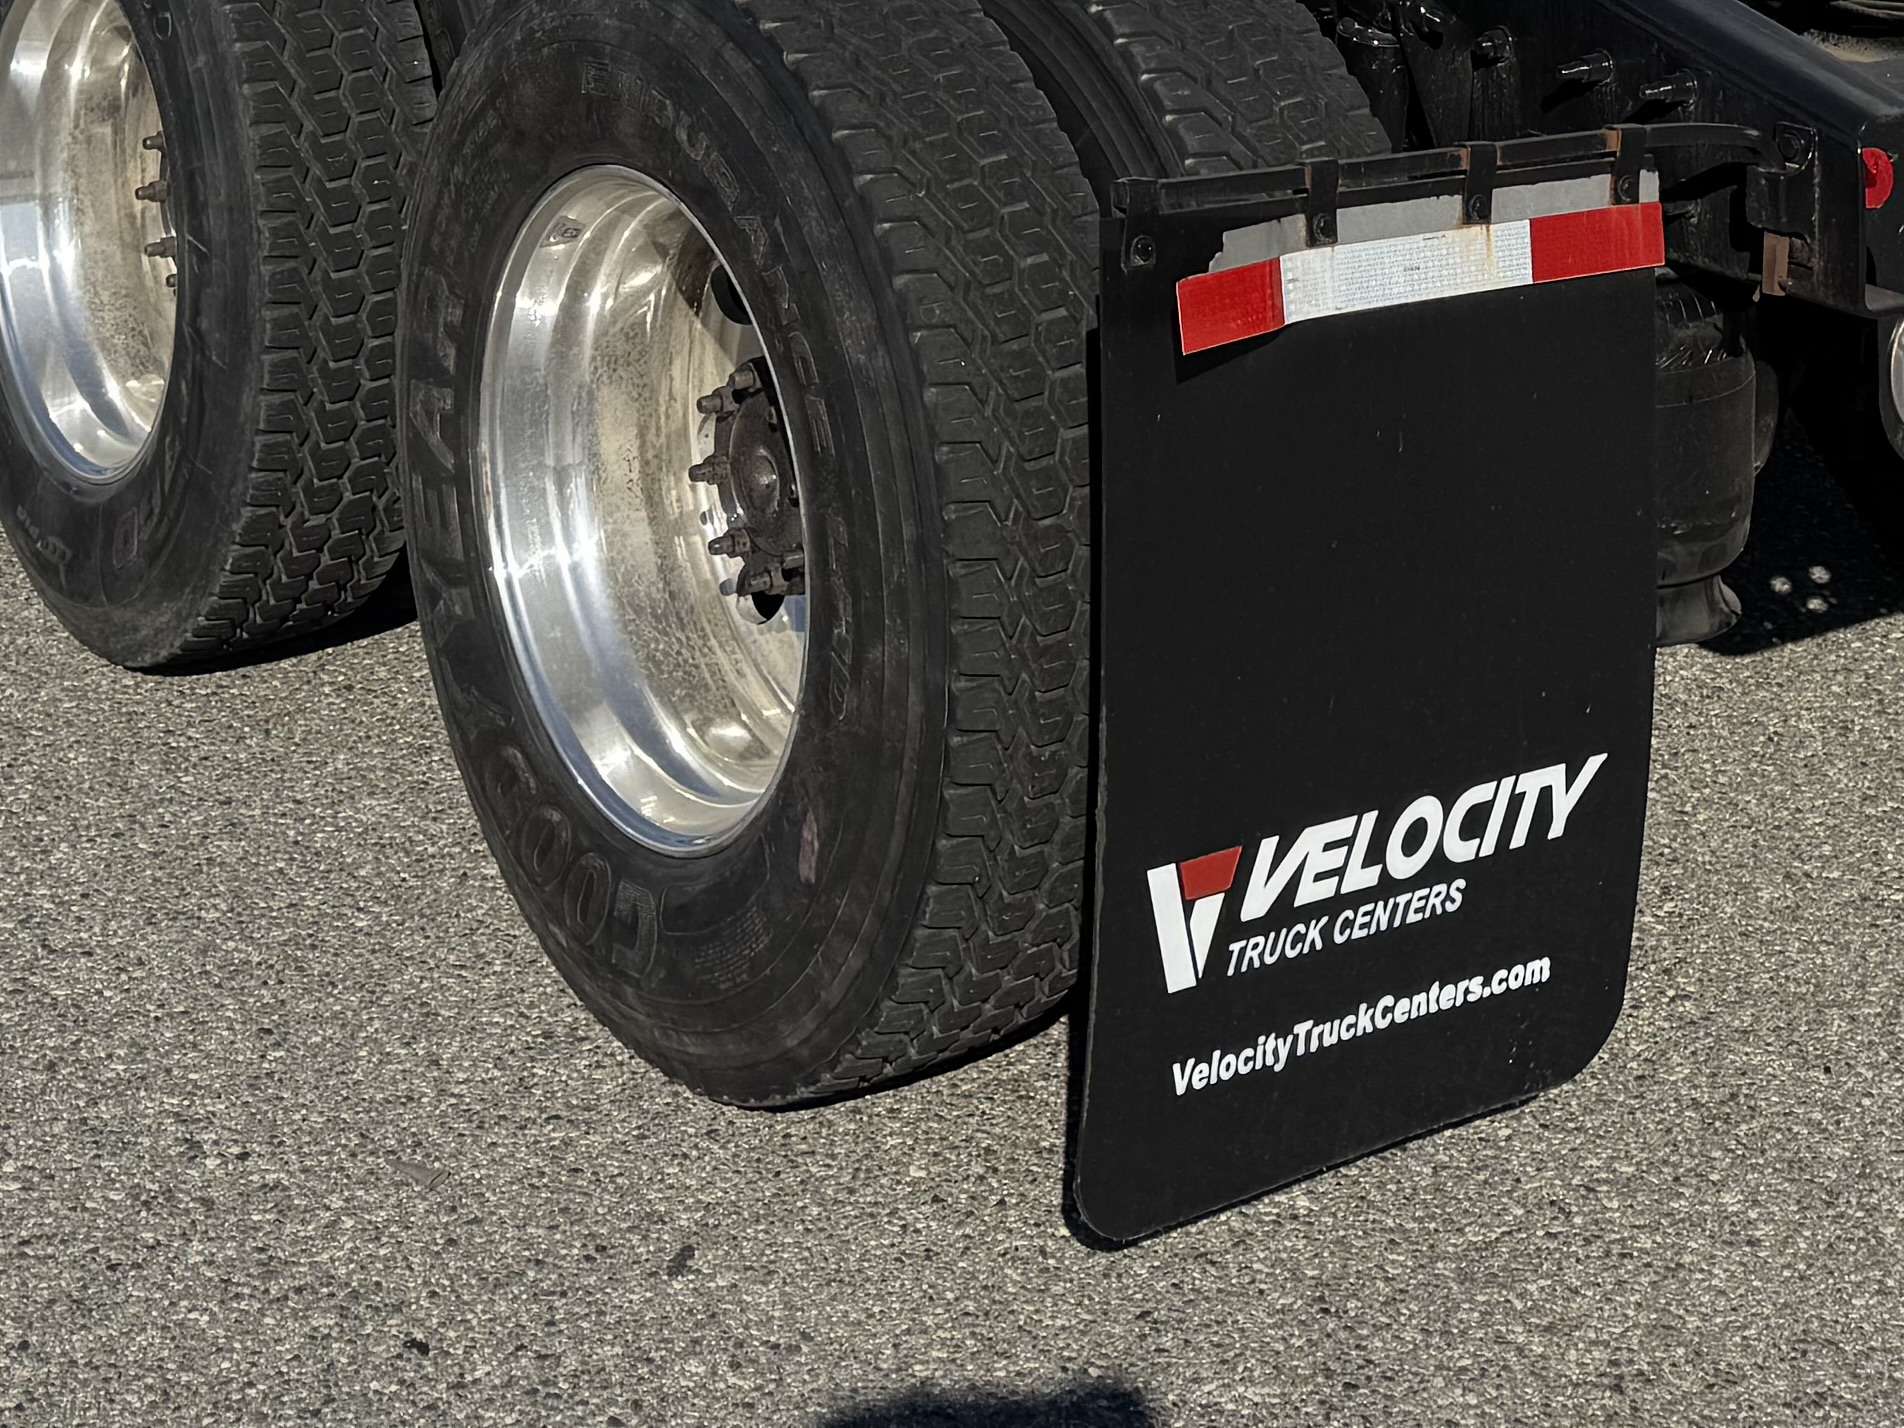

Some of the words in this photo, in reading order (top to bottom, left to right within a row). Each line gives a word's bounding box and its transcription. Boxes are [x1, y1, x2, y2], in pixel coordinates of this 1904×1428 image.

[1240, 752, 1608, 922] VELOCITY
[1226, 915, 1329, 976] TRUCK
[1333, 878, 1467, 945] CENTERS
[1172, 957, 1550, 1095] VelocityTruckCenters.com
